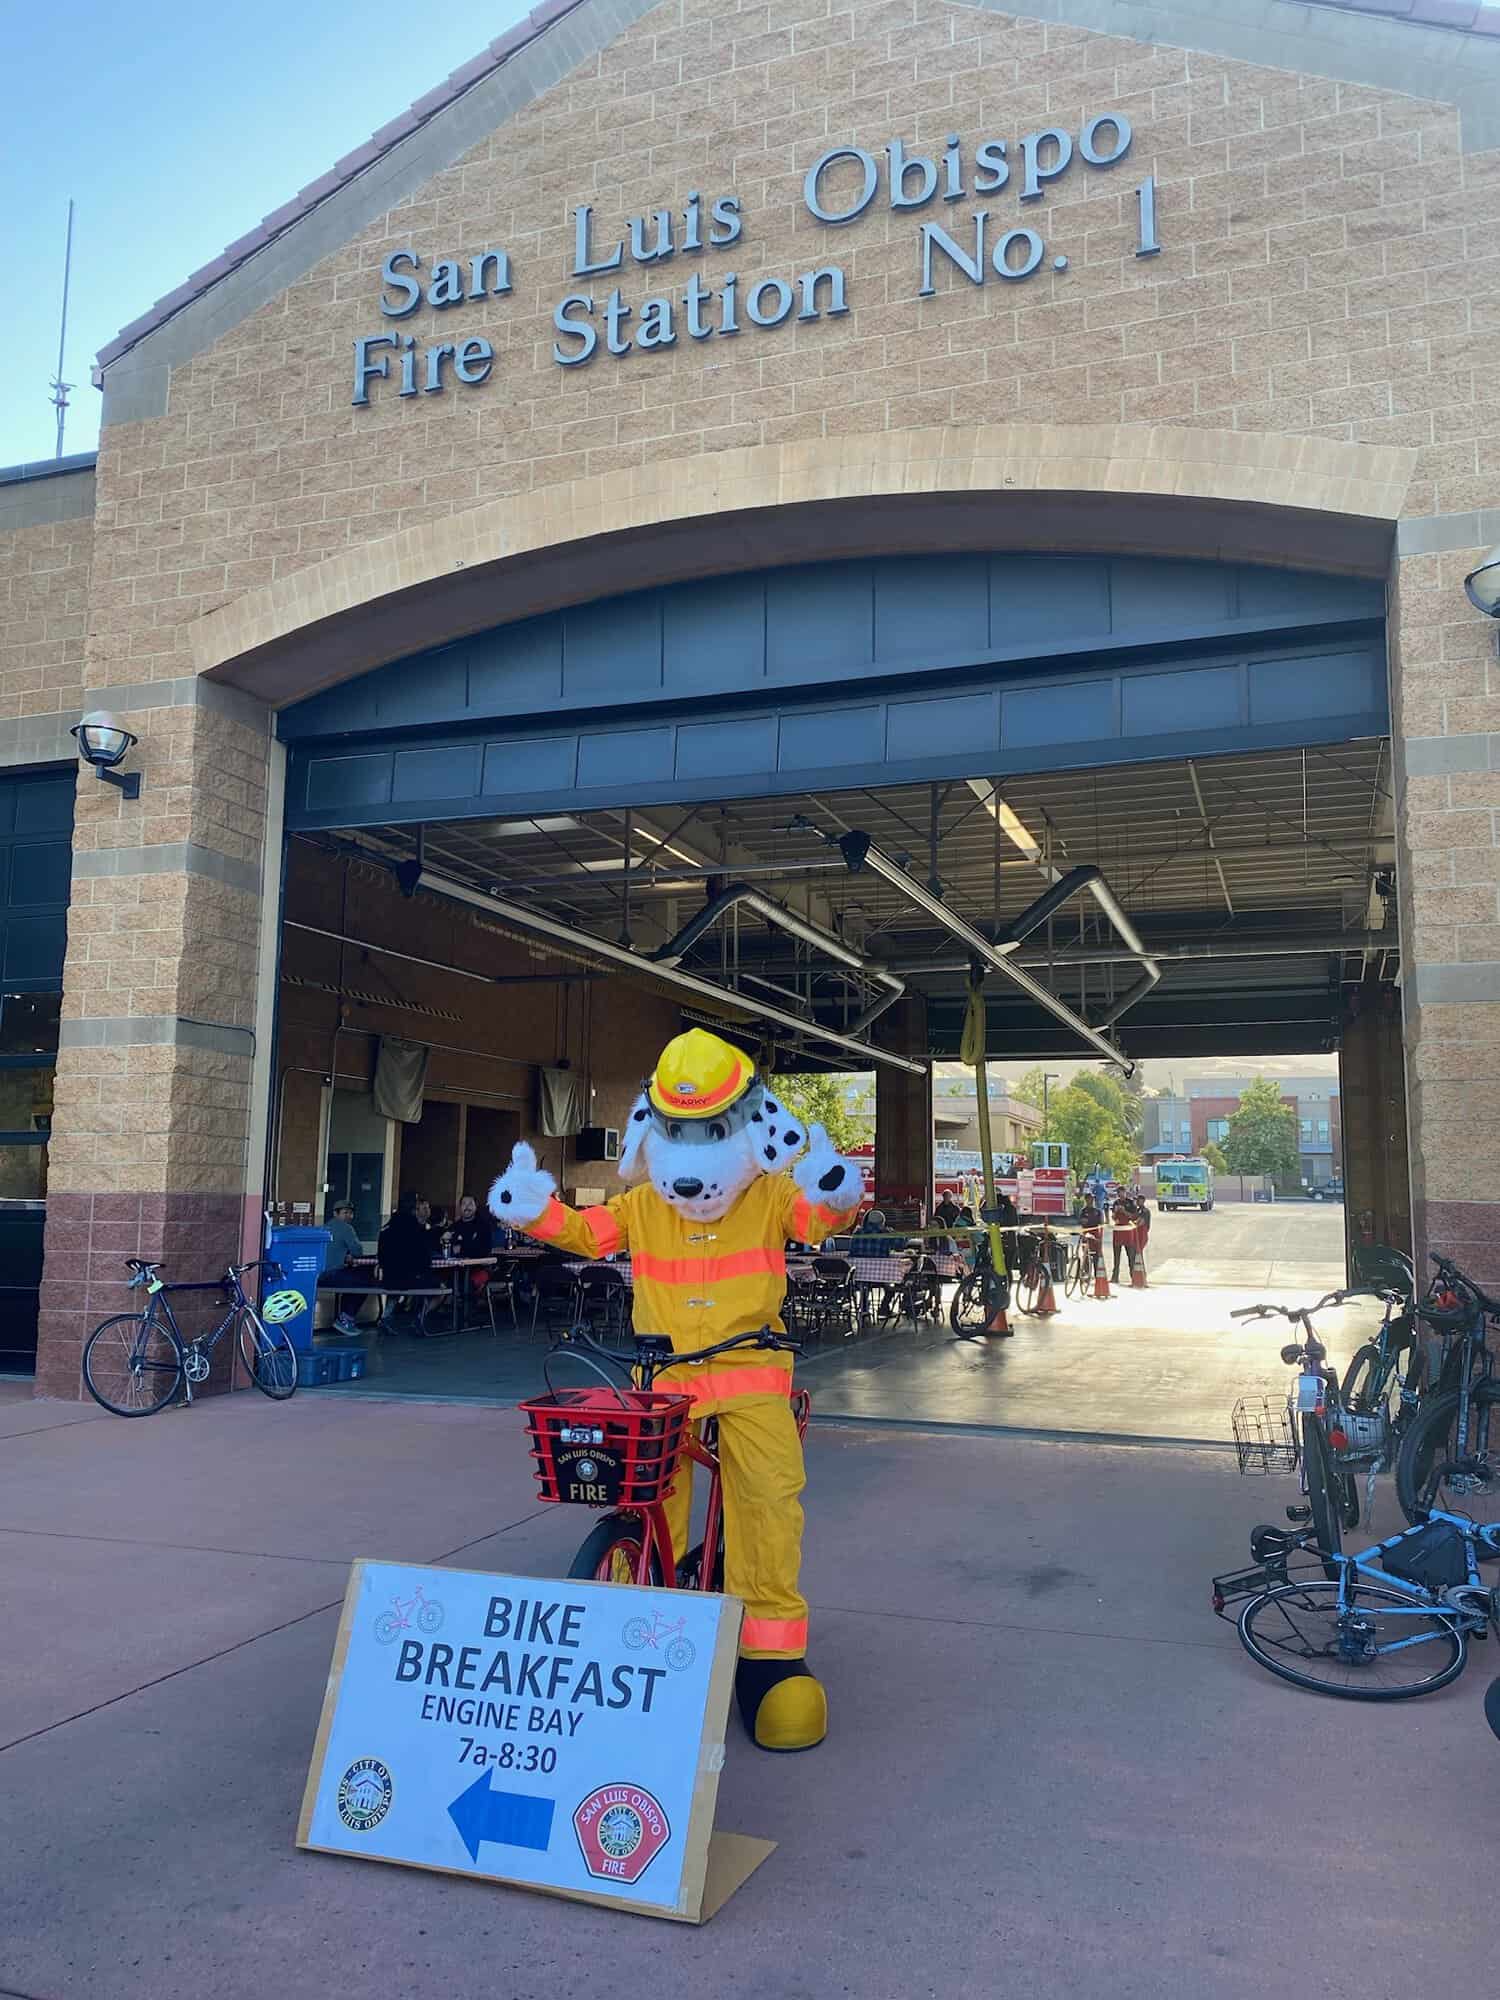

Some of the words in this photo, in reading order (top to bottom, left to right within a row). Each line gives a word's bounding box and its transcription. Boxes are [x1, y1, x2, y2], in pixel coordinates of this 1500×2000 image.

[380, 245, 512, 318] San
[572, 191, 741, 277] Luis
[805, 111, 1132, 224] Obispo
[350, 332, 494, 406] Fire
[553, 264, 850, 367] Station
[919, 210, 1068, 298] No.
[1135, 174, 1161, 259] 1
[570, 1483, 608, 1500] FIRE
[484, 1596, 586, 1648] BIKE
[395, 1639, 666, 1713] BREAKFAST
[421, 1694, 520, 1731] ENGINE
[528, 1705, 584, 1737] BAY
[457, 1737, 557, 1774] 7a-8:30
[581, 1798, 602, 1825] SAN
[603, 1790, 629, 1805] LUIS
[631, 1794, 661, 1836] OBISPO
[602, 1858, 626, 1875] FIRE
